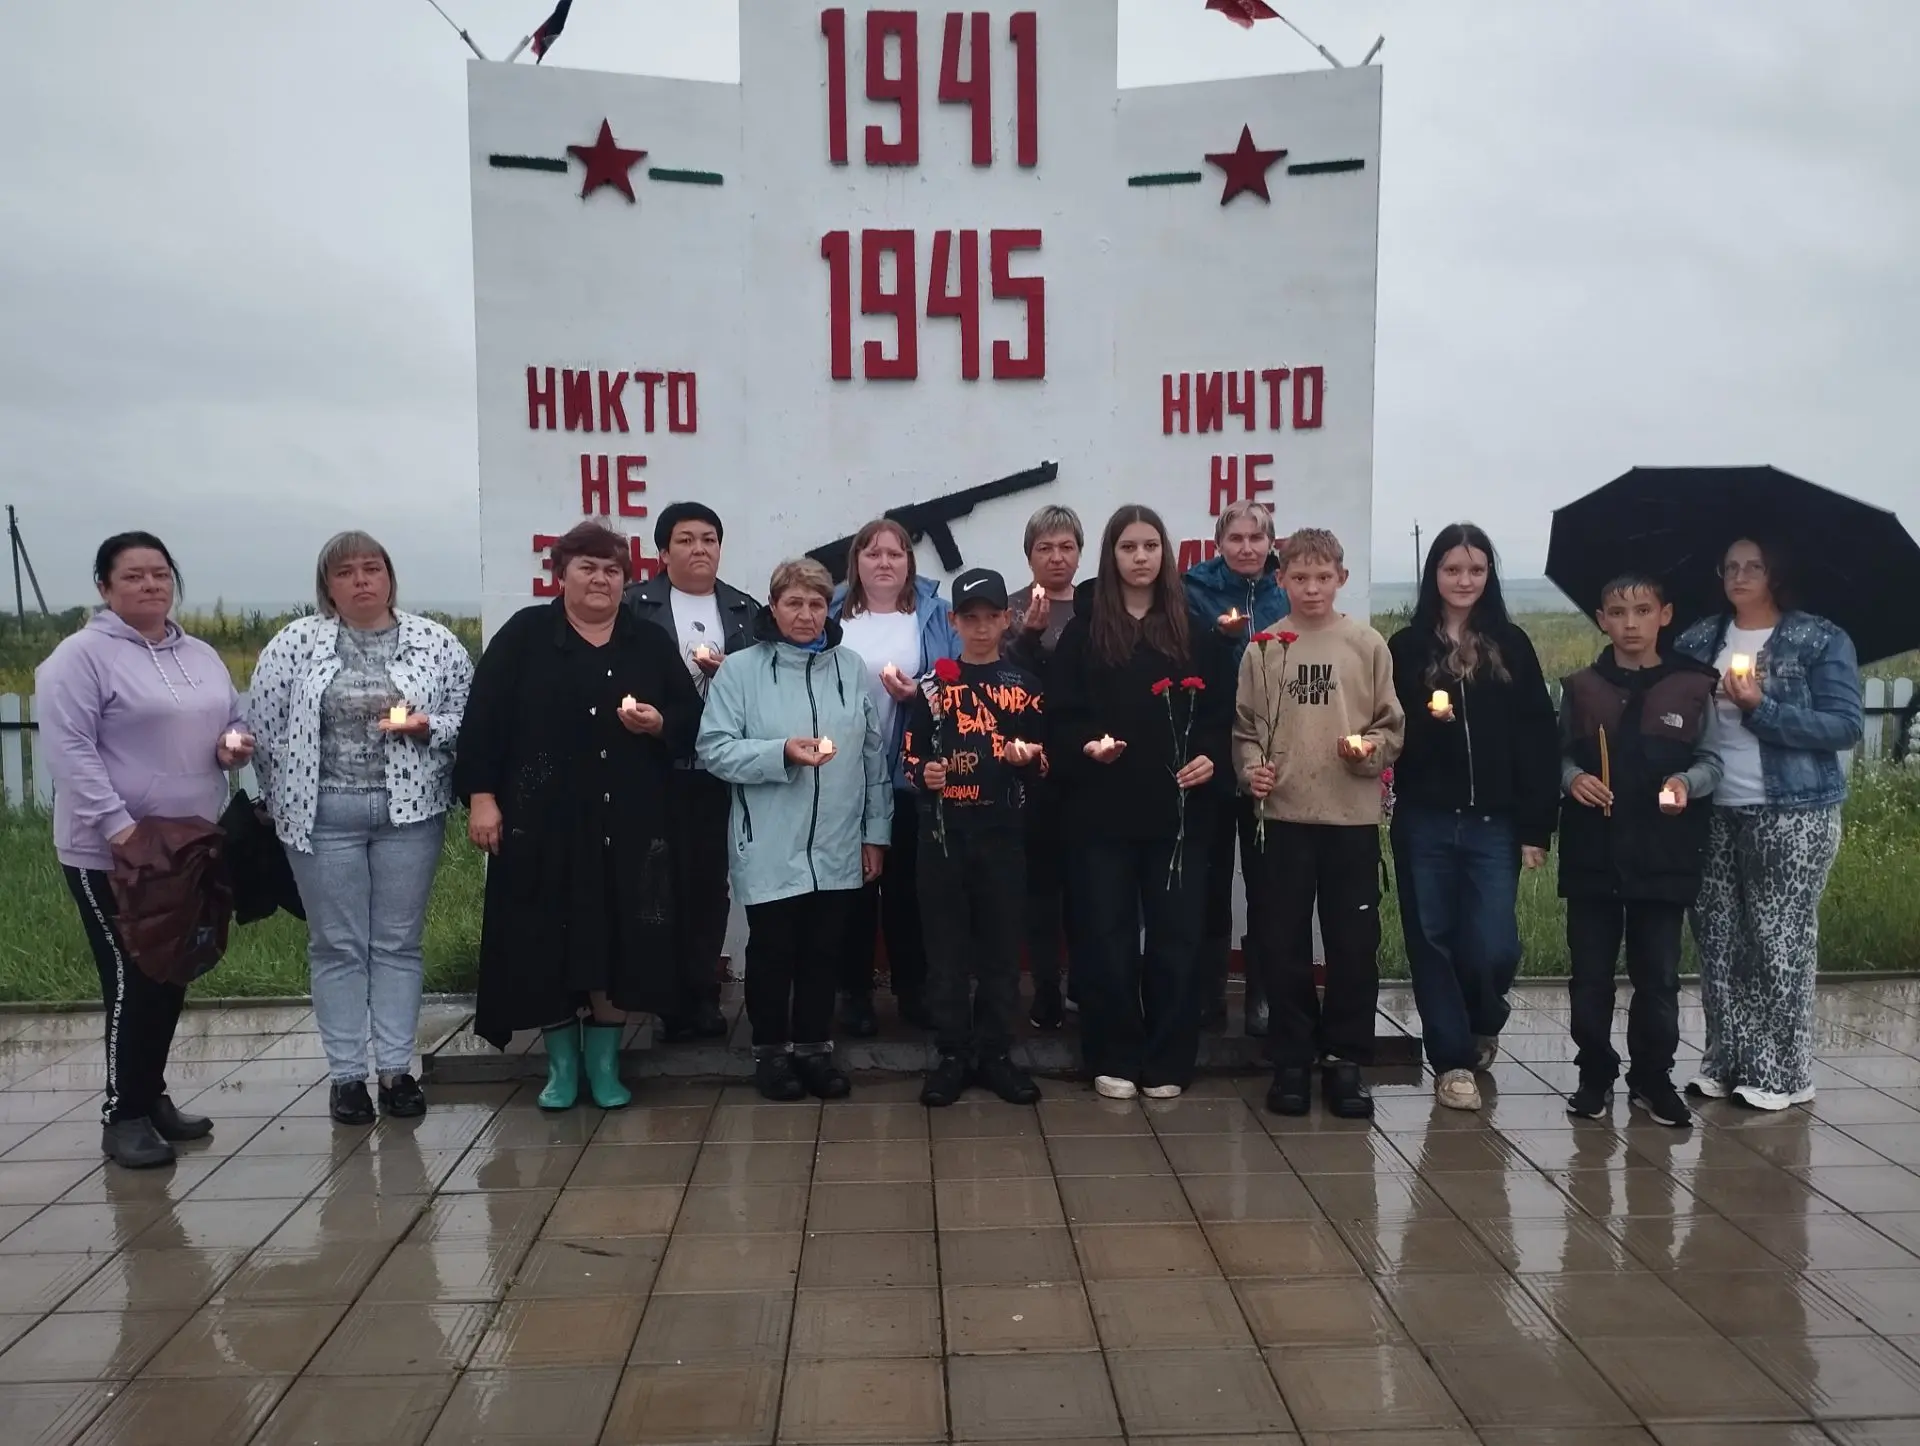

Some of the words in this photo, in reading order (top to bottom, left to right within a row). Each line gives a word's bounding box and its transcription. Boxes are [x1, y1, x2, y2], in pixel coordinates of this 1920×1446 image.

[821, 8, 1038, 167] 1941
[821, 229, 1045, 380] 1945
[527, 367, 697, 433] НИКТО
[1162, 366, 1324, 434] НИЧТО
[581, 454, 648, 517] НЕ
[1209, 454, 1275, 516] НЕ
